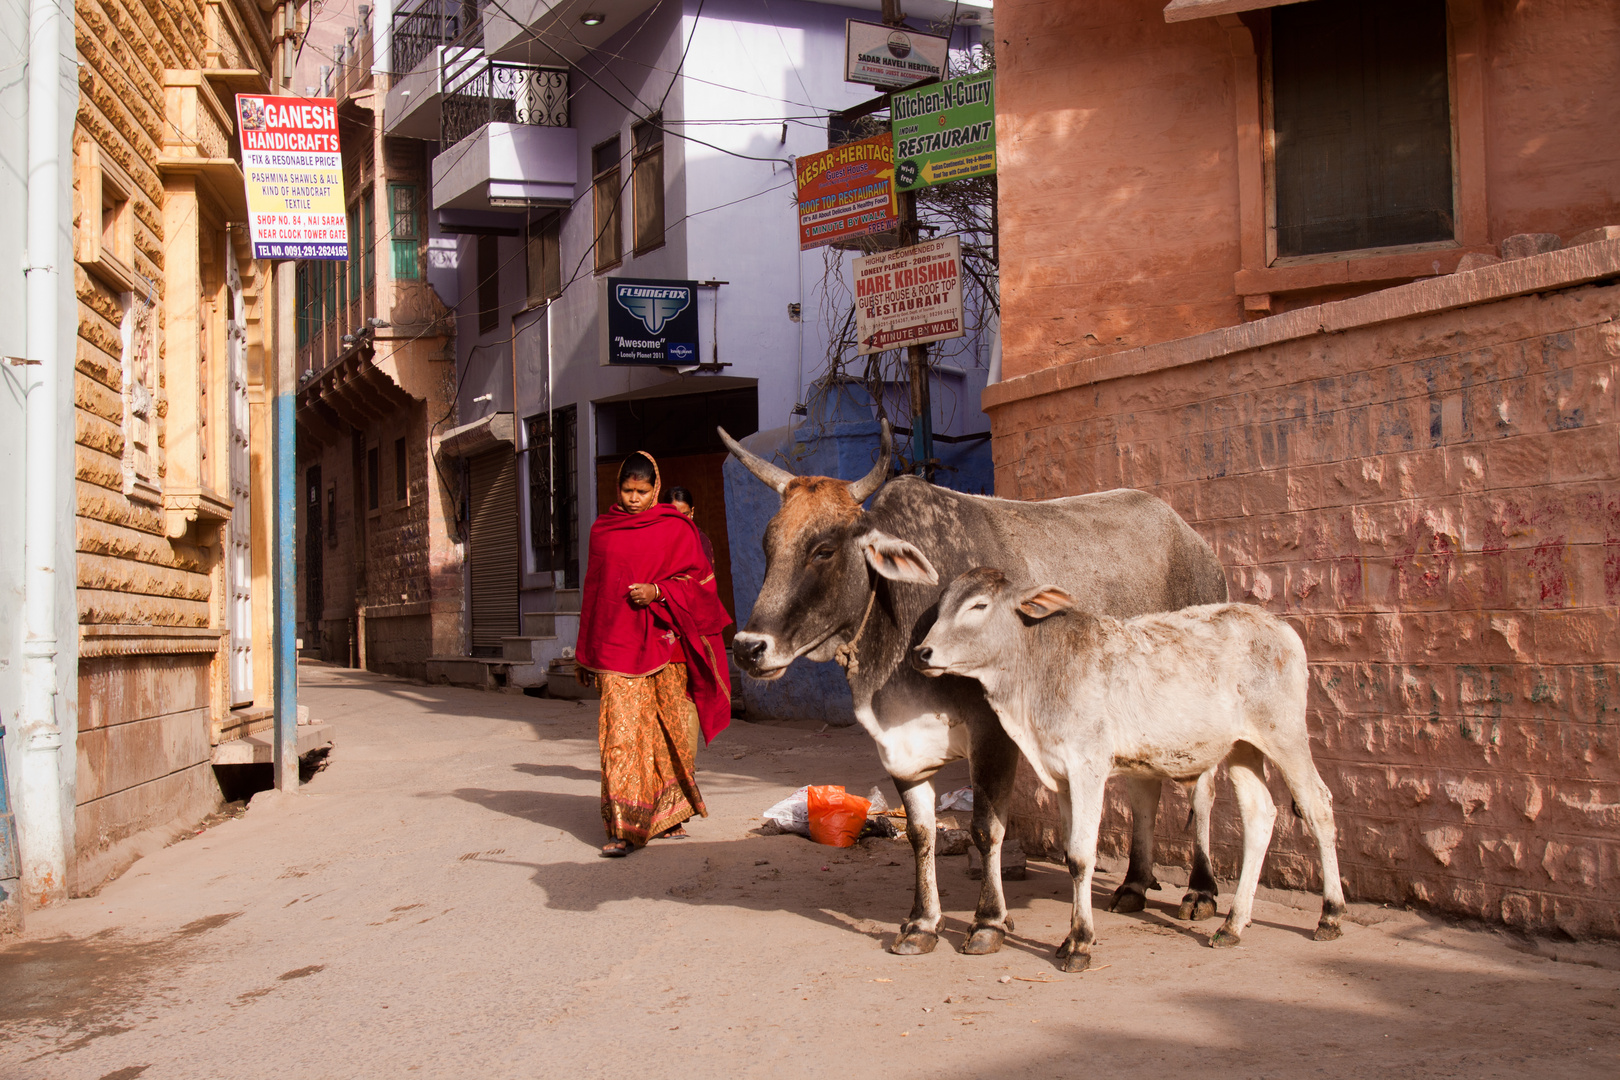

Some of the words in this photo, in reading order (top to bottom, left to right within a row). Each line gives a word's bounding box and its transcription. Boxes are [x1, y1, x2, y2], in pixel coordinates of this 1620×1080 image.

[858, 54, 880, 64] SADAR
[883, 58, 906, 68] HAVELI
[908, 62, 939, 73] HERITAGE
[894, 80, 991, 120] Kitchen-N-Curry
[265, 104, 335, 129] GANESH
[899, 125, 918, 135] INDIAN
[248, 132, 338, 151] HANDICRAFTS
[898, 121, 992, 158] RESTAURANT
[265, 155, 270, 164] &
[273, 155, 313, 166] RESONABLE
[826, 167, 845, 180] Guest
[847, 163, 868, 174] House
[901, 165, 914, 174] wi-fi
[252, 173, 288, 183] PASHMINA
[291, 173, 318, 184] SHAWLS
[320, 174, 324, 184] &
[327, 174, 338, 184] ALL
[900, 175, 913, 184] free
[262, 186, 279, 195] KIND
[281, 186, 289, 196] OF
[292, 187, 330, 196] HANDCRAFT
[800, 199, 819, 215] ROOF
[821, 194, 836, 209] TOP
[839, 180, 888, 205] RESTAURANT
[285, 199, 311, 209] TEXTILE
[832, 207, 852, 215] Delicious
[857, 201, 874, 209] Healthy
[257, 215, 276, 225] SHOP
[279, 215, 290, 225] NO.
[293, 216, 300, 225] 84
[308, 216, 319, 225] NAI
[322, 216, 344, 225] SARAK
[806, 228, 810, 237] 1
[812, 220, 844, 236] MINUTE
[848, 216, 859, 227] BY
[861, 209, 886, 223] WALK
[868, 221, 884, 233] FREE
[258, 229, 276, 238] NEAR
[279, 229, 301, 239] CLOCK
[304, 230, 327, 239] TOWER
[330, 230, 346, 239] GATE
[258, 246, 271, 256] TEL
[271, 246, 284, 256] NO.
[284, 246, 347, 256] 0091-291-2624165
[866, 255, 886, 266] HIGHLY
[888, 245, 935, 260] RECOMMENDED
[861, 267, 882, 276] LONELY
[884, 261, 907, 272] PLANET
[913, 255, 931, 265] 2009
[857, 273, 891, 297] HARE
[895, 259, 957, 289] KRISHNA
[620, 288, 686, 299] FLYINGFOX
[859, 294, 883, 308] GUEST
[885, 289, 910, 303] HOUSE
[912, 287, 917, 297] &
[919, 282, 939, 296] ROOF
[941, 279, 956, 293] TOP
[866, 292, 949, 318] RESTAURANT
[873, 336, 878, 344] 2
[880, 329, 913, 343] MINUTE
[918, 326, 929, 336] BY
[932, 321, 958, 333] WALK
